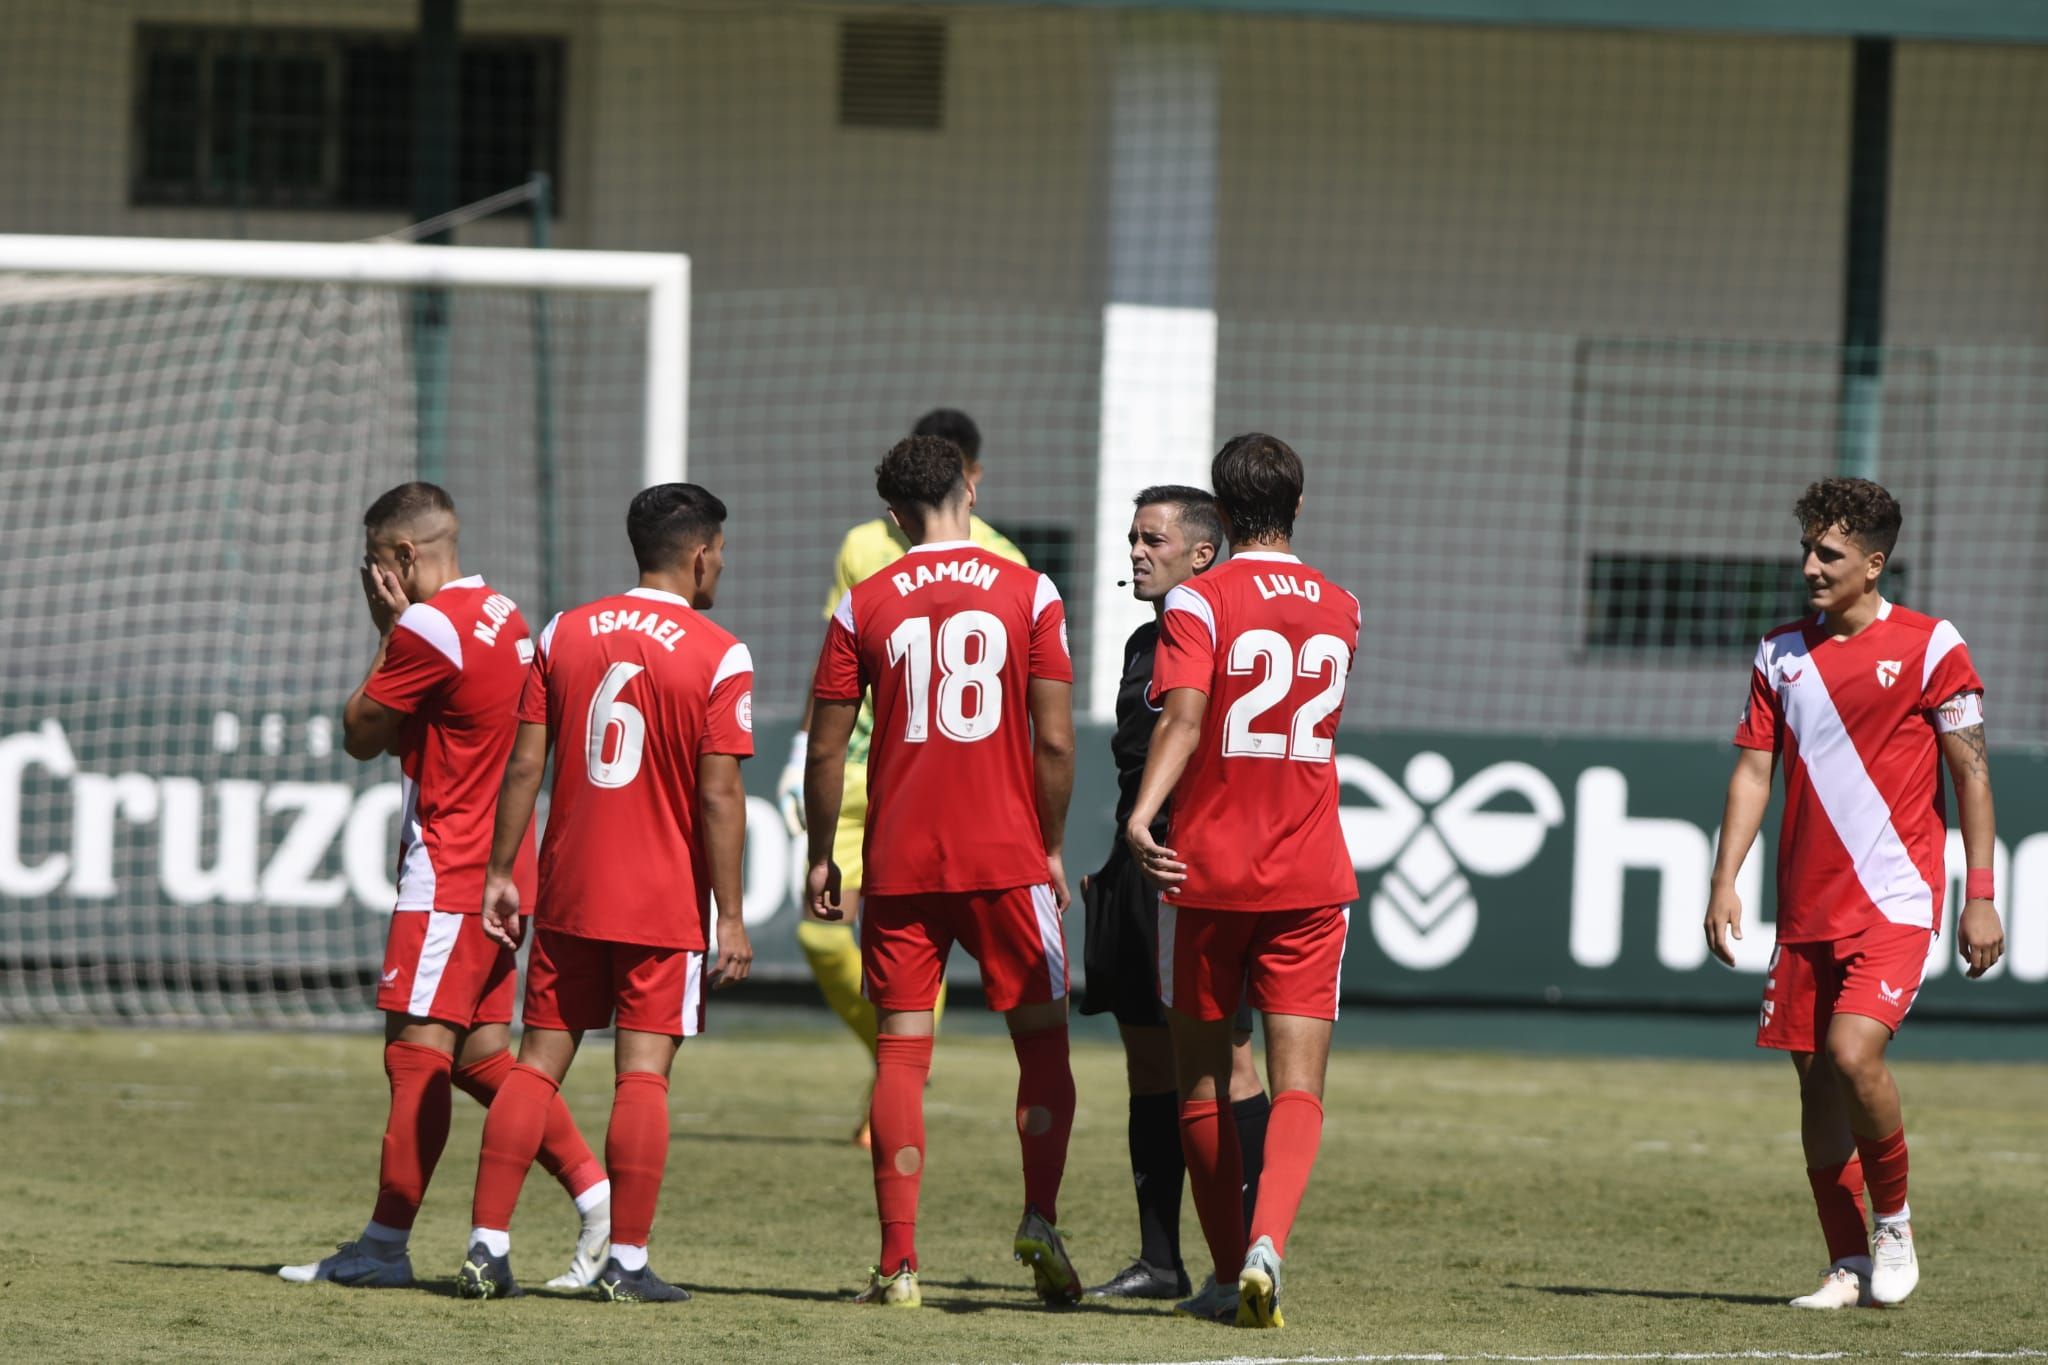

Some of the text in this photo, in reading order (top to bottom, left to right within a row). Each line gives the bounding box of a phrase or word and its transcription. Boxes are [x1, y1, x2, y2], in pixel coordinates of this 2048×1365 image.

[891, 558, 1000, 597] RAMÓN
[1253, 574, 1321, 603] LULO
[588, 610, 687, 653] ISMAEL
[886, 610, 1008, 743] 18
[1222, 629, 1351, 763] 22
[585, 661, 646, 789] 6
